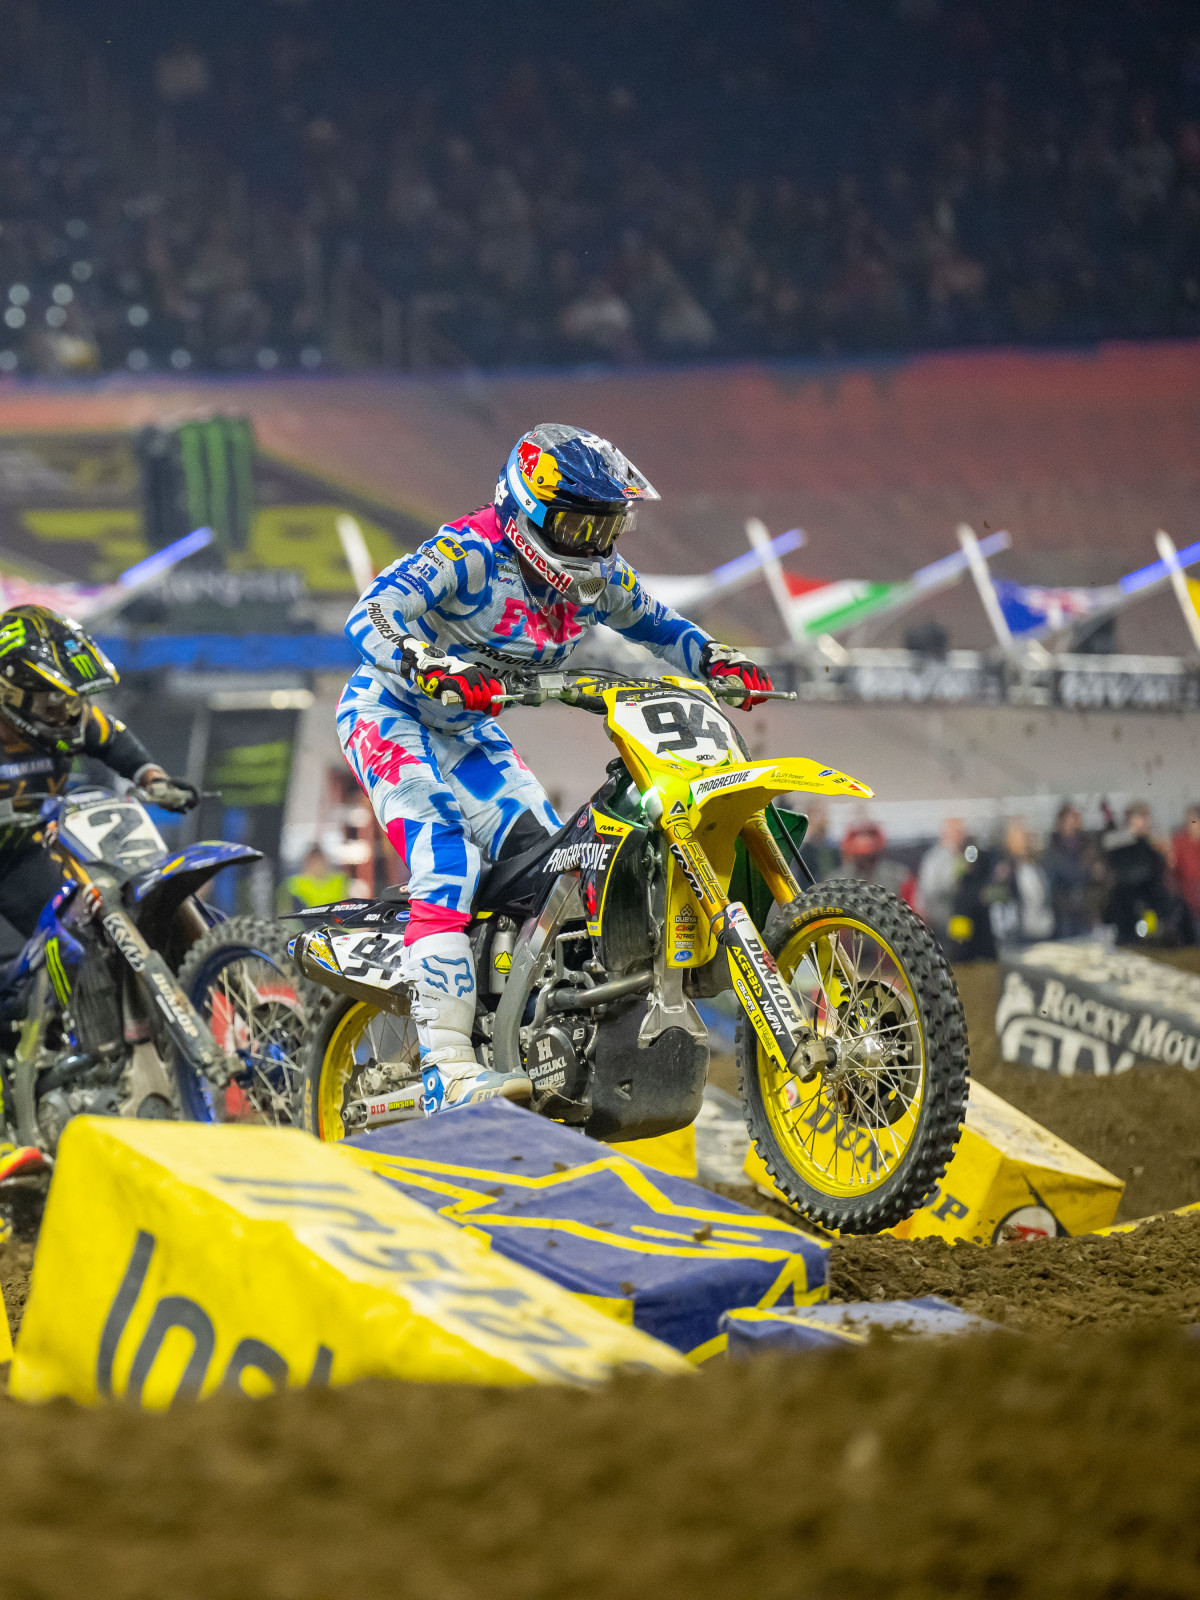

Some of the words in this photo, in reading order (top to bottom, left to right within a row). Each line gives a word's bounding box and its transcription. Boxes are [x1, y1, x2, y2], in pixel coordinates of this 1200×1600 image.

[641, 701, 729, 755] 94
[696, 770, 751, 796] PROGRESSIVE
[542, 842, 612, 874] PROGRESSIVE
[745, 937, 804, 1024] DUNLOP
[1036, 978, 1131, 1045] ROCKY
[528, 1056, 568, 1081] SUZUKI
